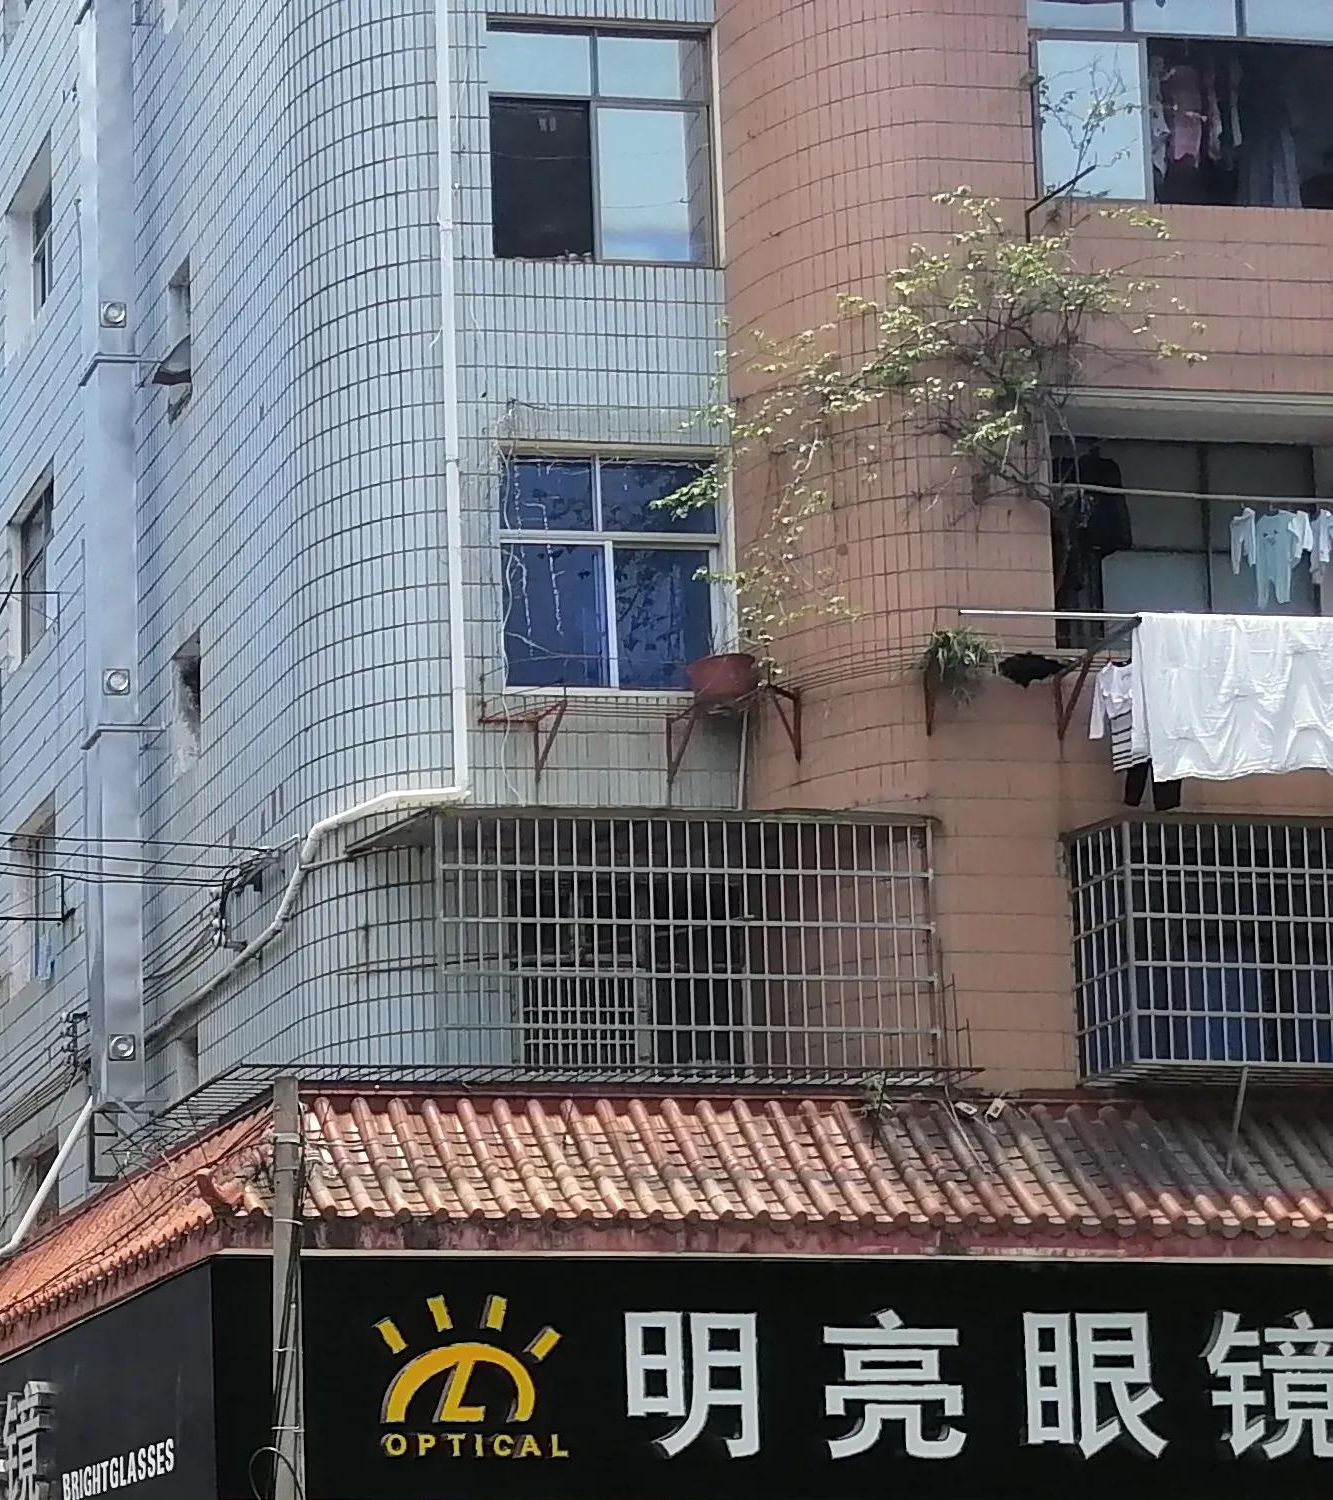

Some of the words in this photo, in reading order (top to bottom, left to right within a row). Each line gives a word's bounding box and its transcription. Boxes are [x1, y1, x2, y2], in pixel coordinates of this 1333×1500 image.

[623, 1308, 1333, 1461] 明亮眼镜
[384, 1433, 570, 1458] OPTICAL
